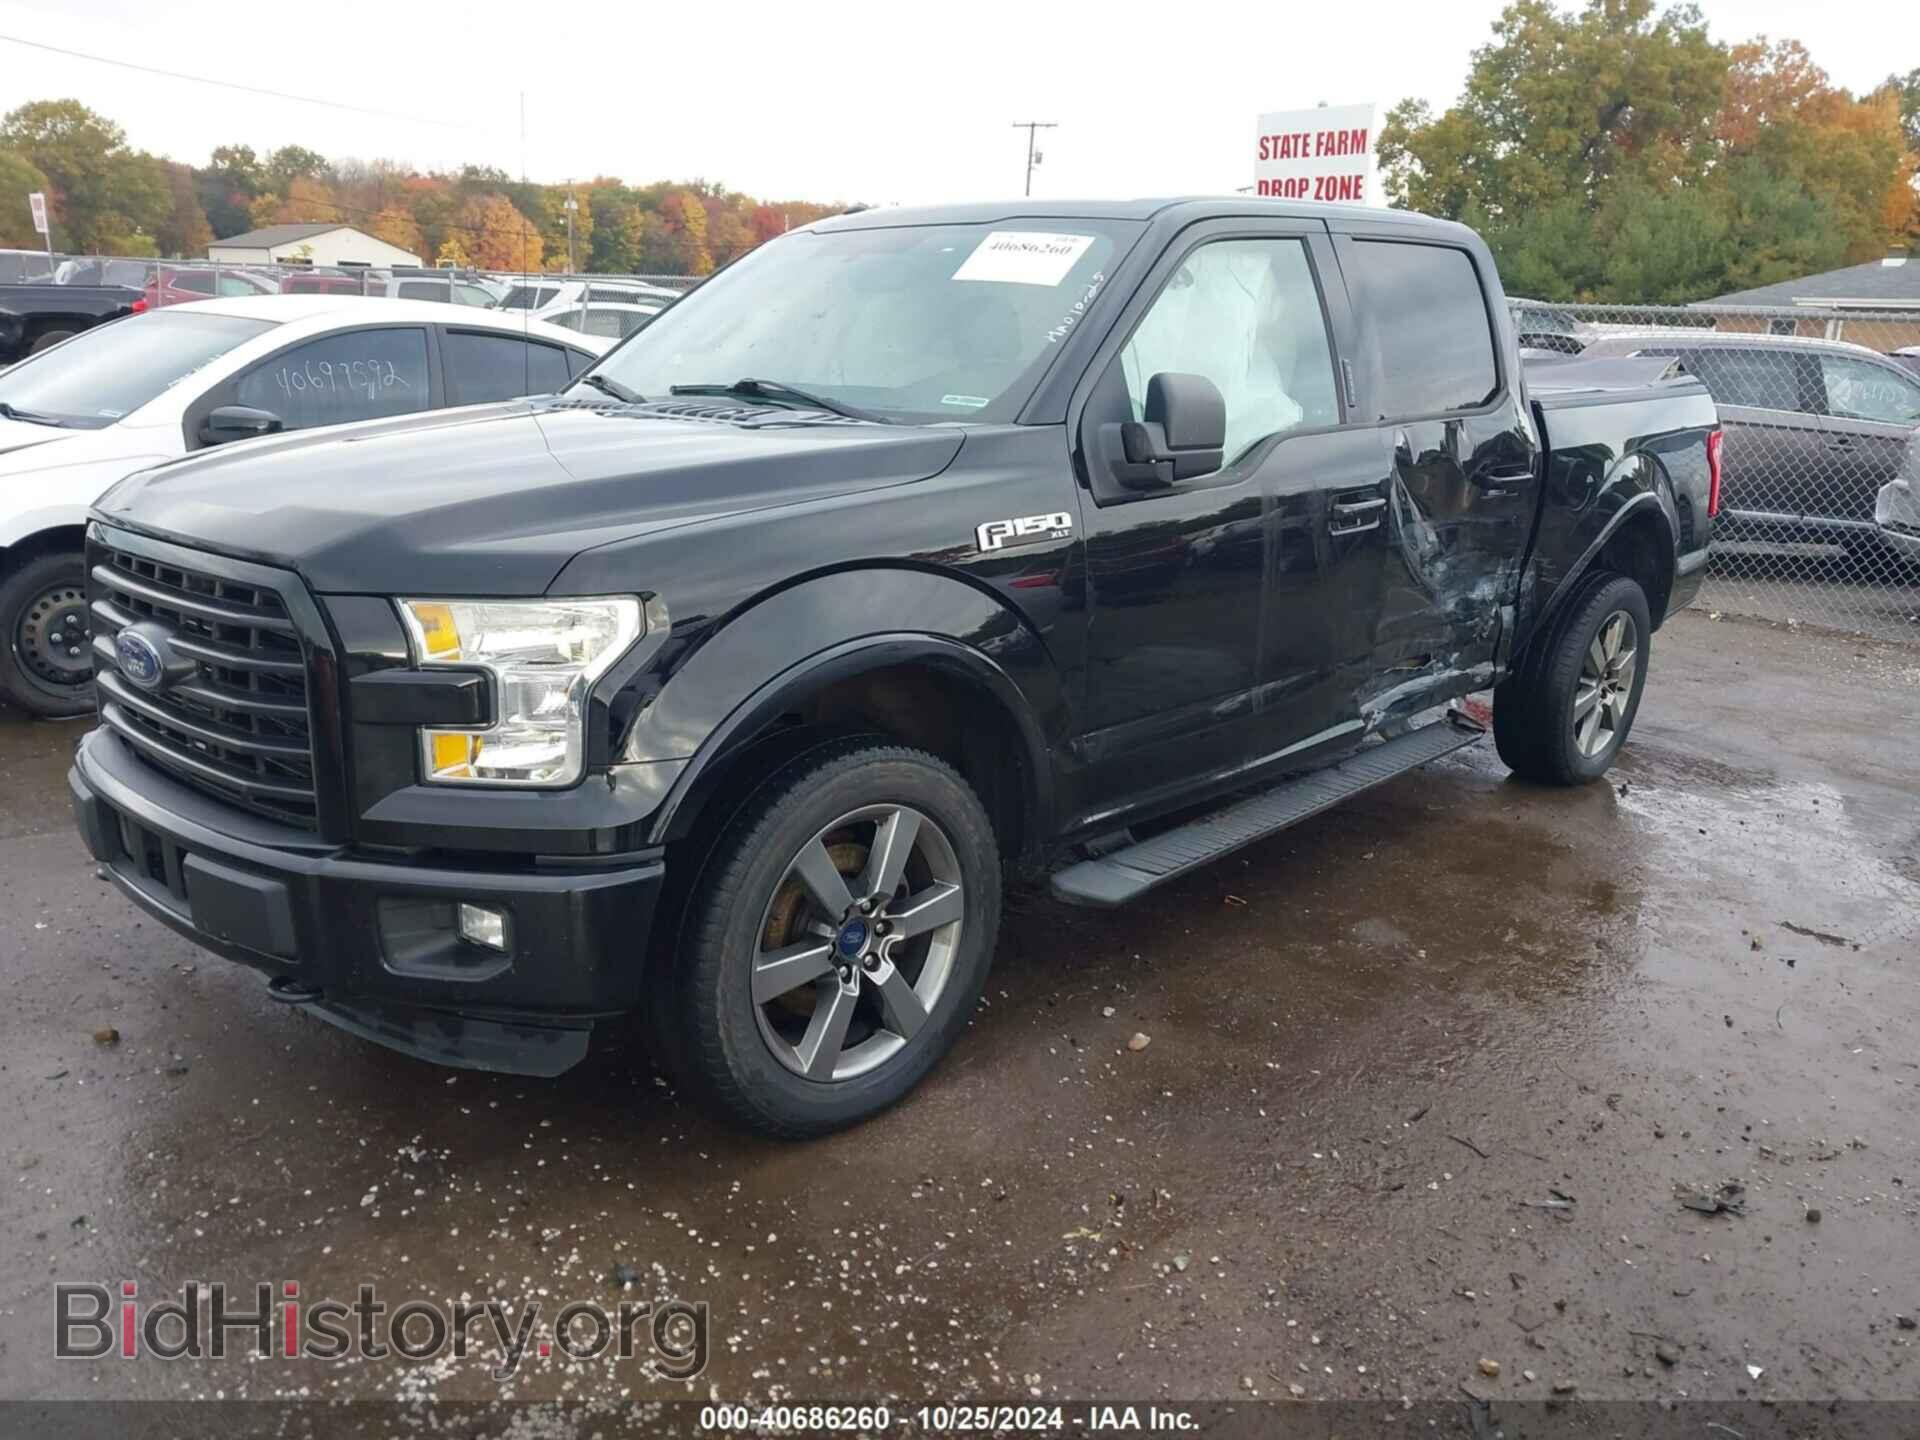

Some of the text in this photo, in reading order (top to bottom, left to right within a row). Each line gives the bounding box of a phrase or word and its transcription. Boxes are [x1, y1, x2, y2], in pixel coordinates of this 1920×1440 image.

[1259, 128, 1367, 160] STATE FARM
[1314, 174, 1364, 201] ZONE
